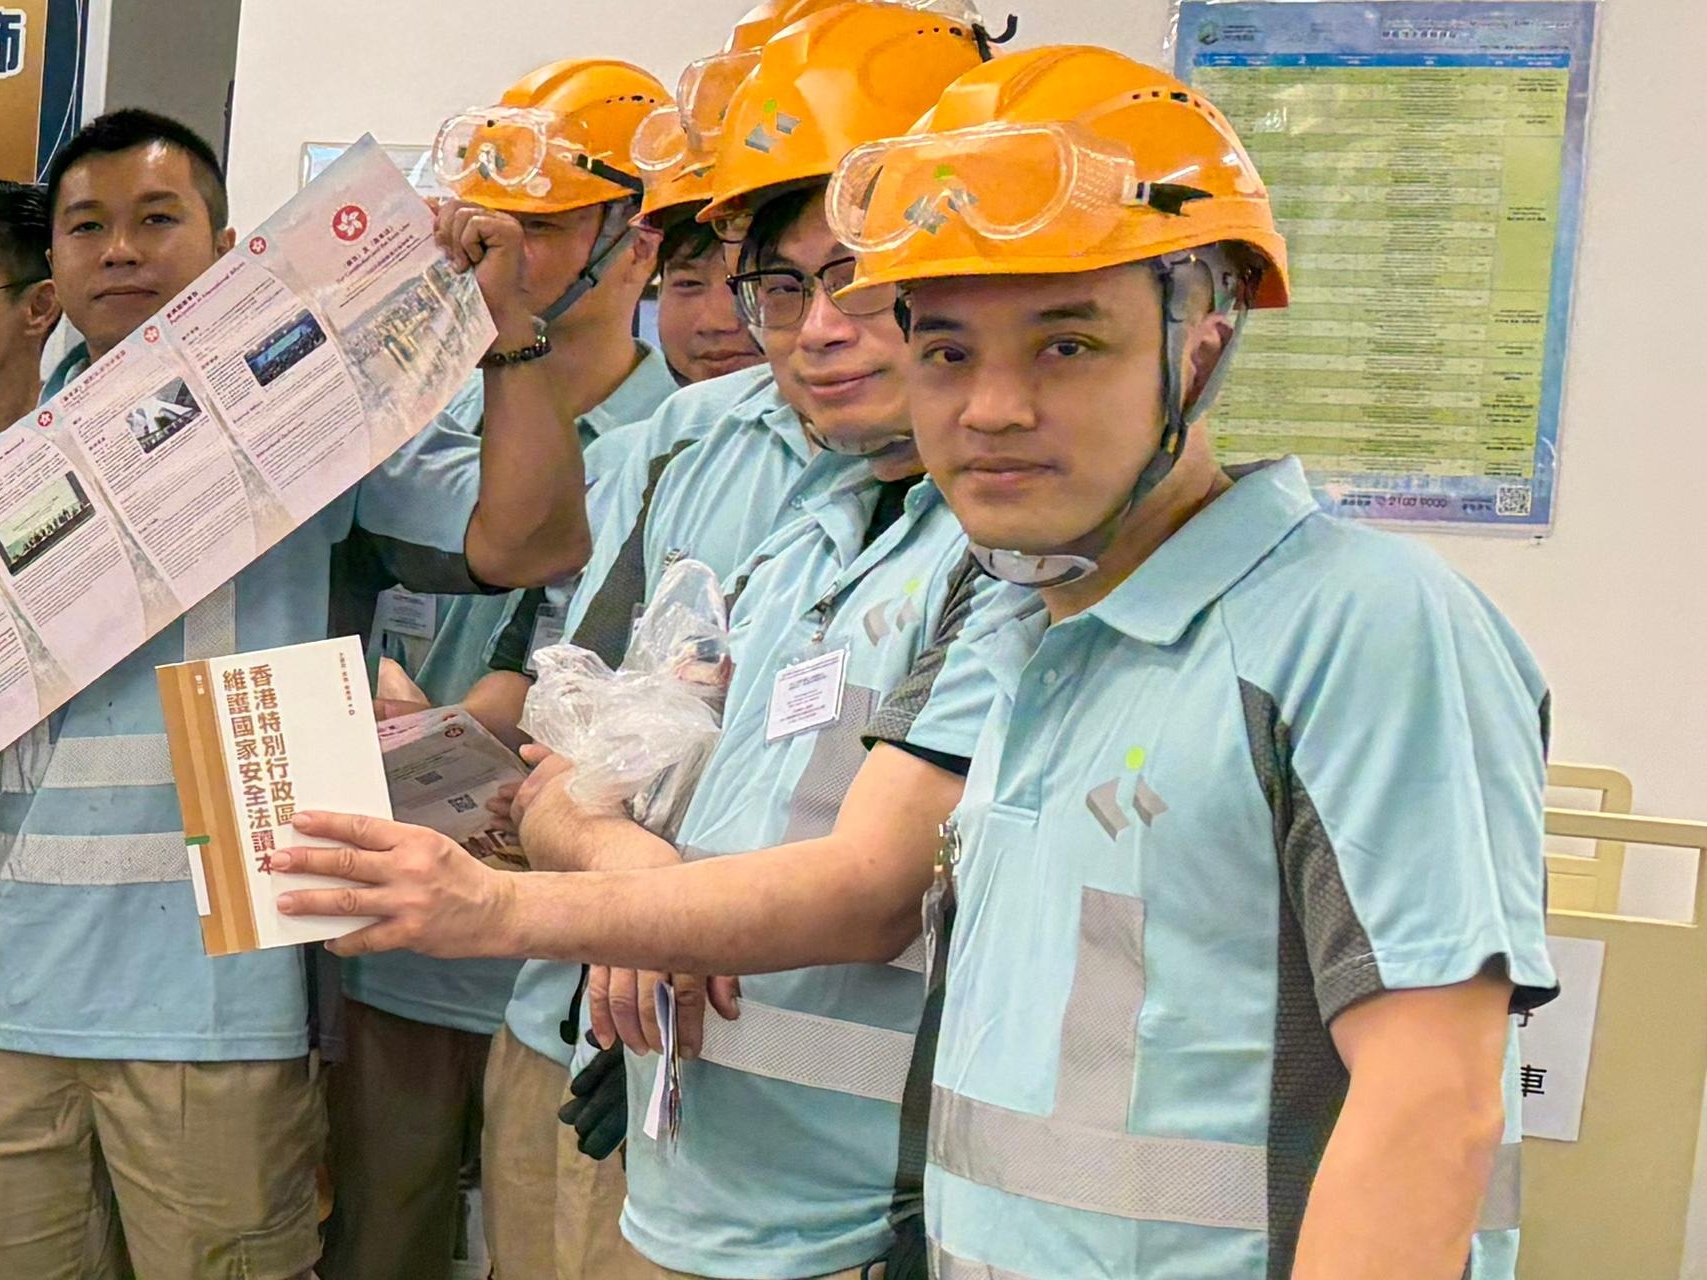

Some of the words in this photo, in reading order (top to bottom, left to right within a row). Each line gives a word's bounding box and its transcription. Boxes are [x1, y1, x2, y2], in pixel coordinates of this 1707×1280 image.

[222, 668, 276, 876] 維護國家安全法讀本
[249, 664, 296, 826] 香港特別行政區
